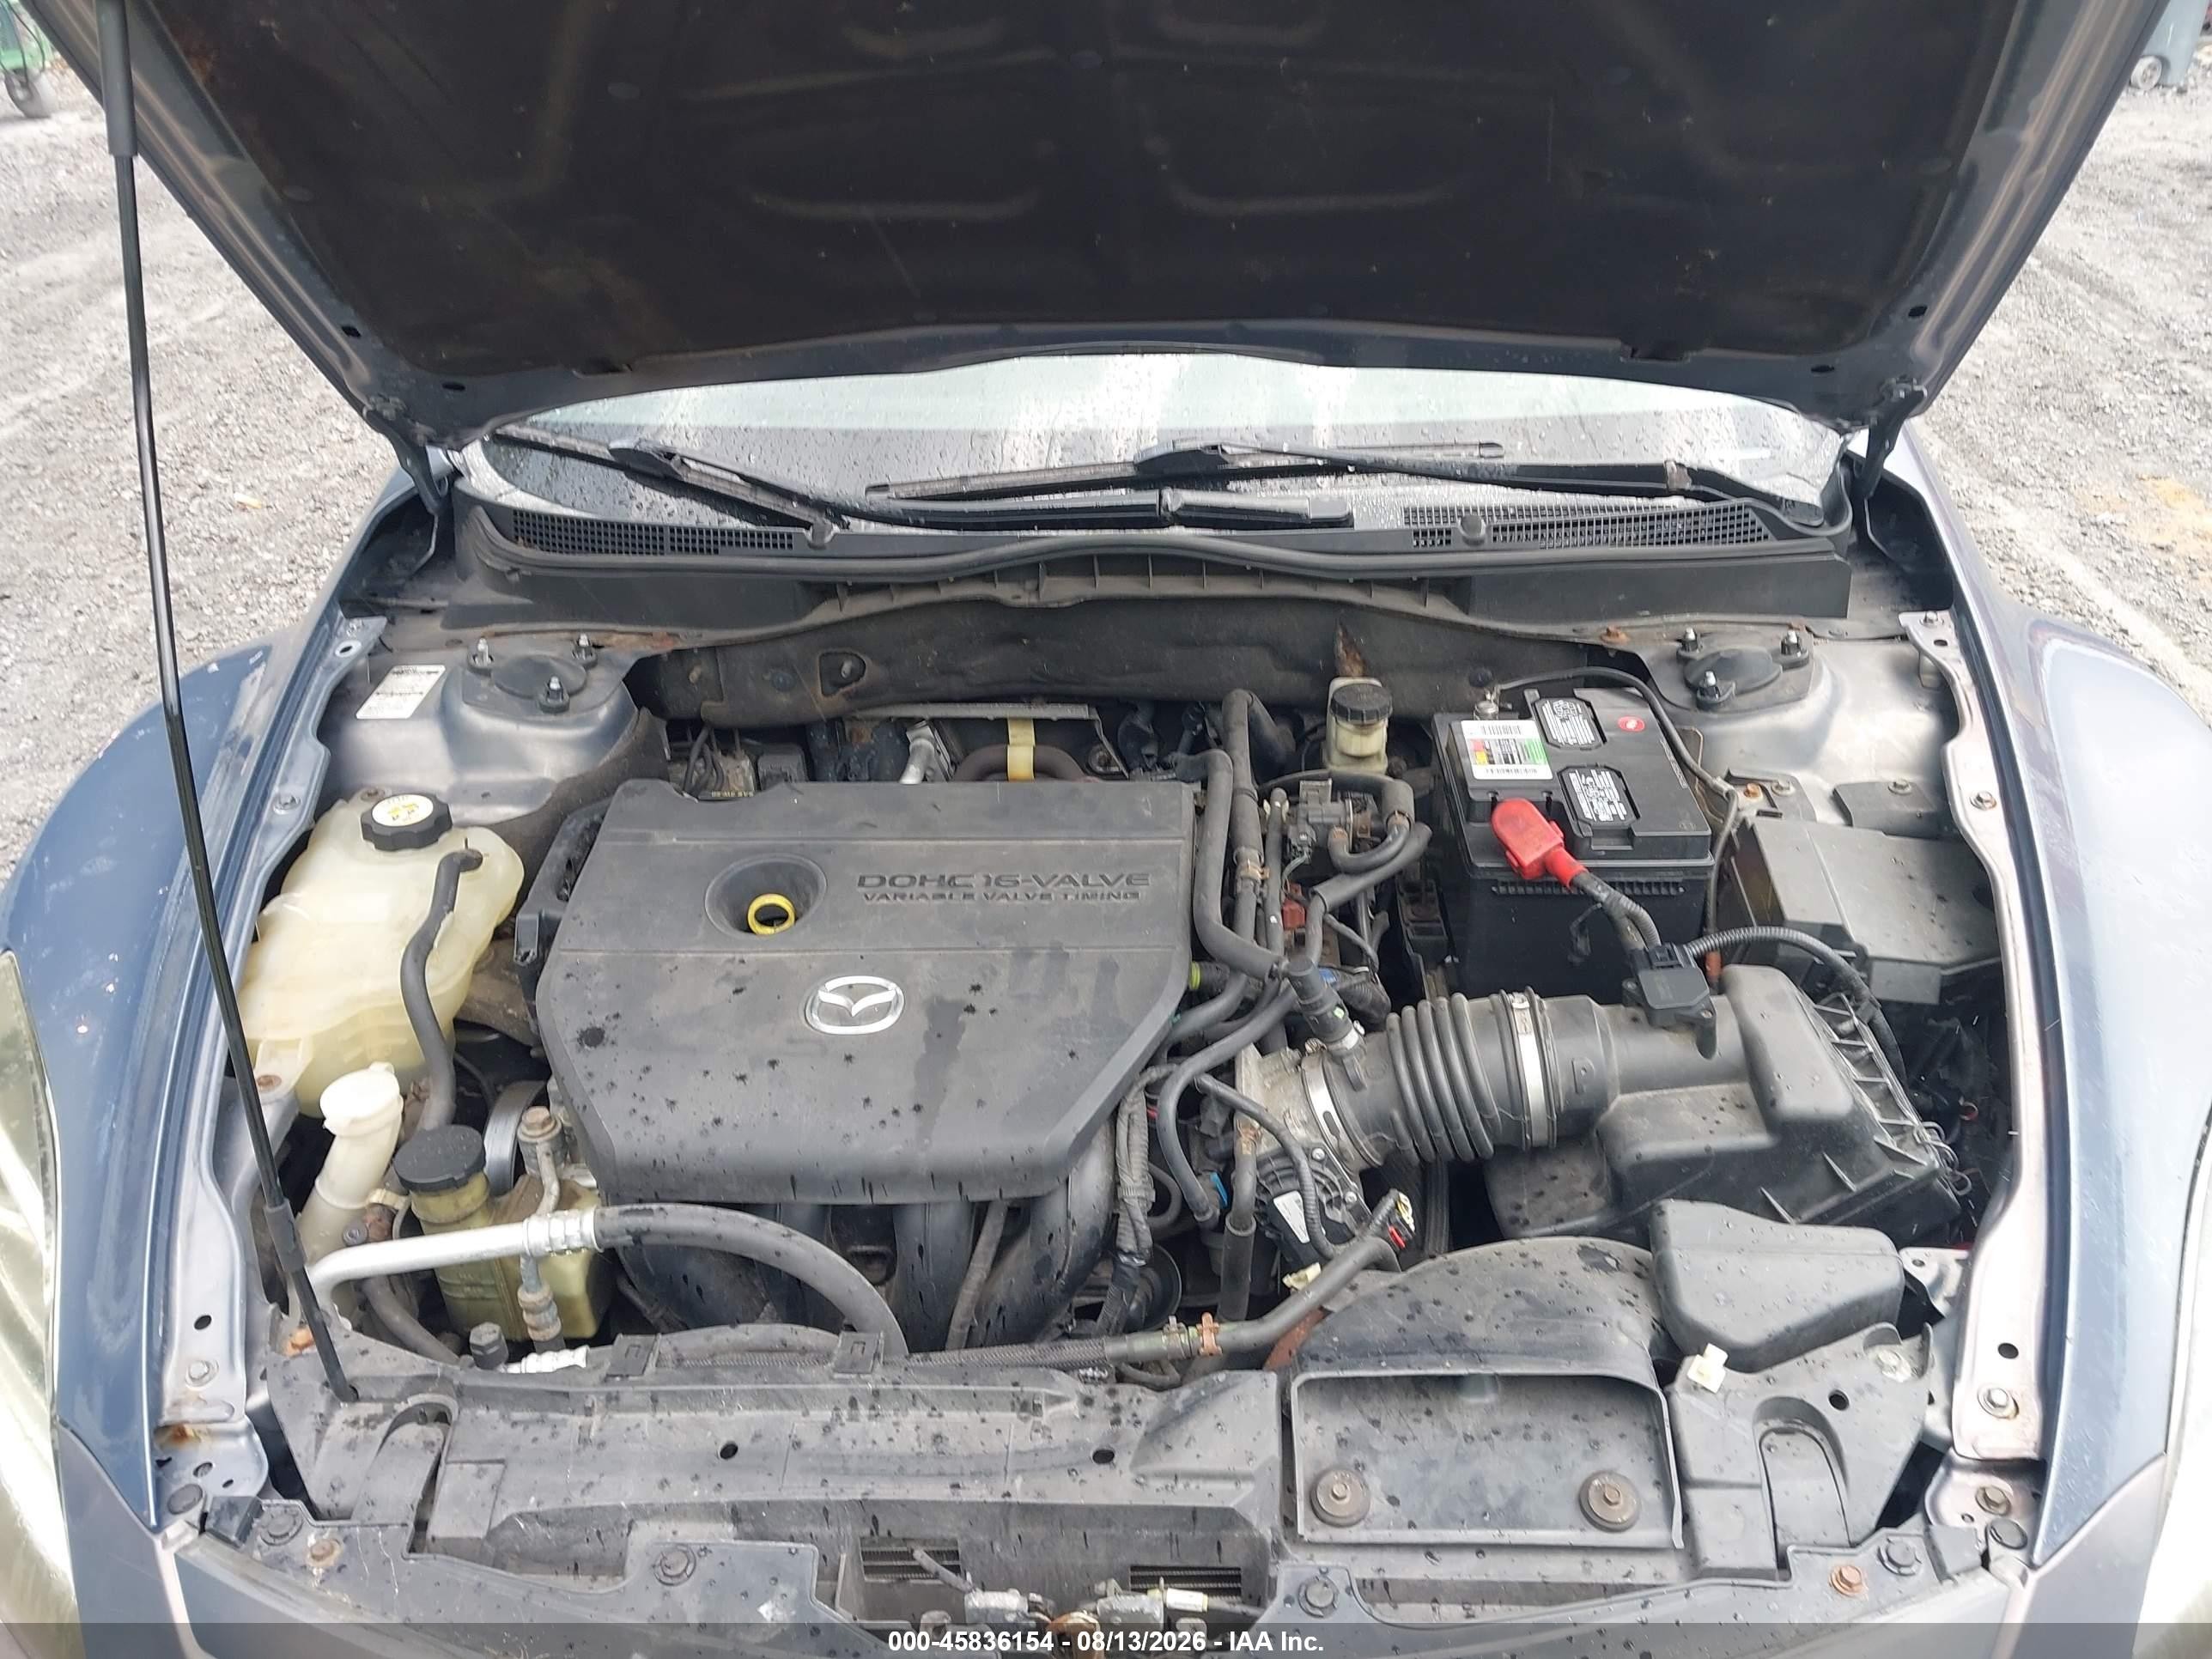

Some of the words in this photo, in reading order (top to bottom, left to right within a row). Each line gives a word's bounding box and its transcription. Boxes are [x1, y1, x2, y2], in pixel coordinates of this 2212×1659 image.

[857, 873, 975, 888] DOHC
[982, 872, 1151, 888] 16-VALVE
[863, 891, 975, 902] VARIABLE
[982, 891, 1054, 902] VALVE
[1063, 891, 1140, 902] TIMING
